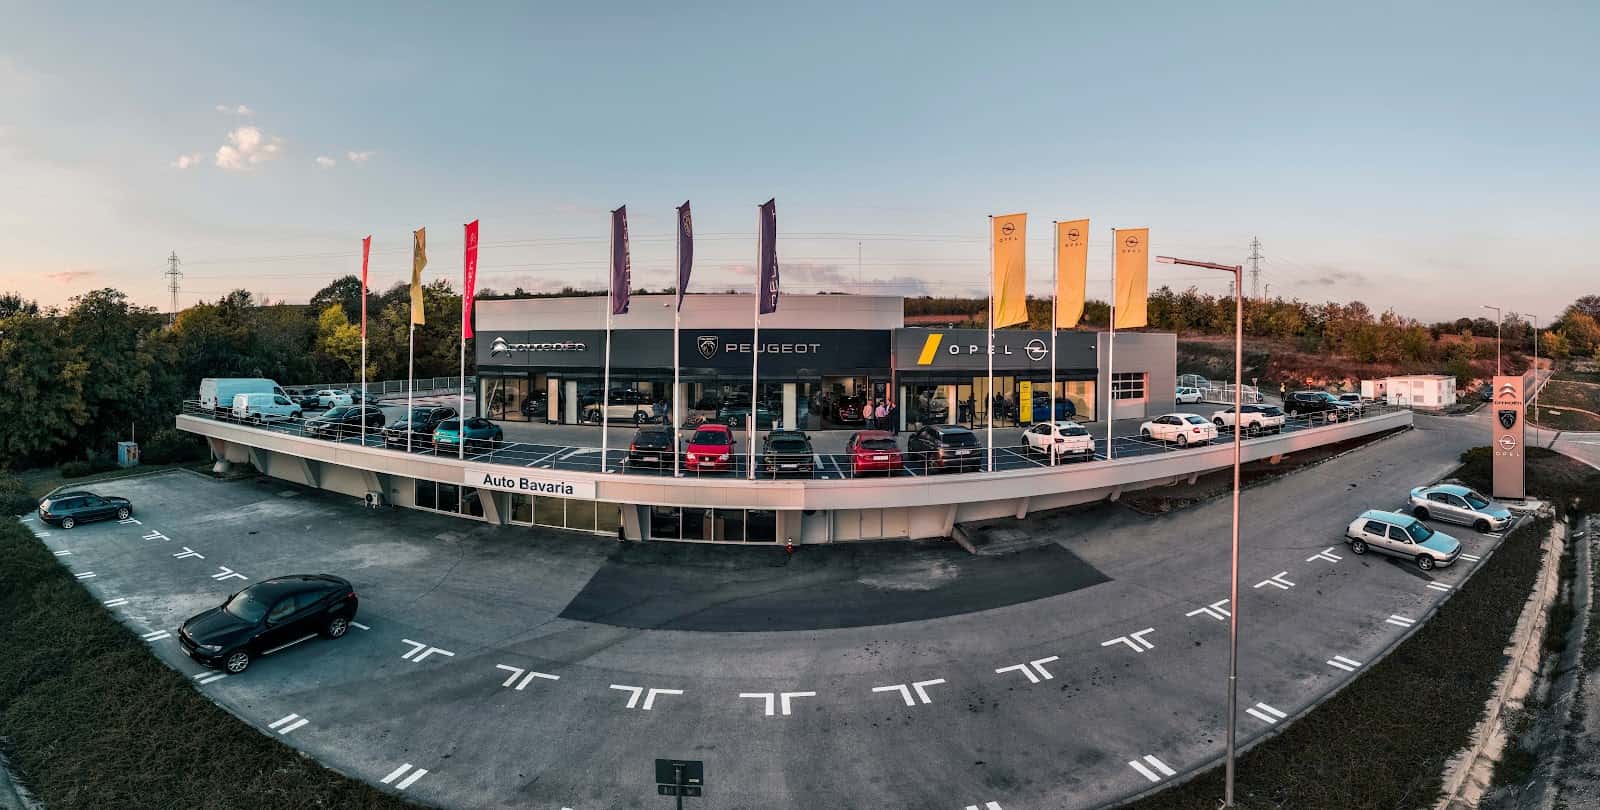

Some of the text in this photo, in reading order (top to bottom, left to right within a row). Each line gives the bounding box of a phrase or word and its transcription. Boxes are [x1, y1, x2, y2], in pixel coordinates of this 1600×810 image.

[725, 343, 821, 354] PEUGEOT
[949, 344, 1013, 355] OPEL
[483, 473, 574, 495] Auto Bavaria
